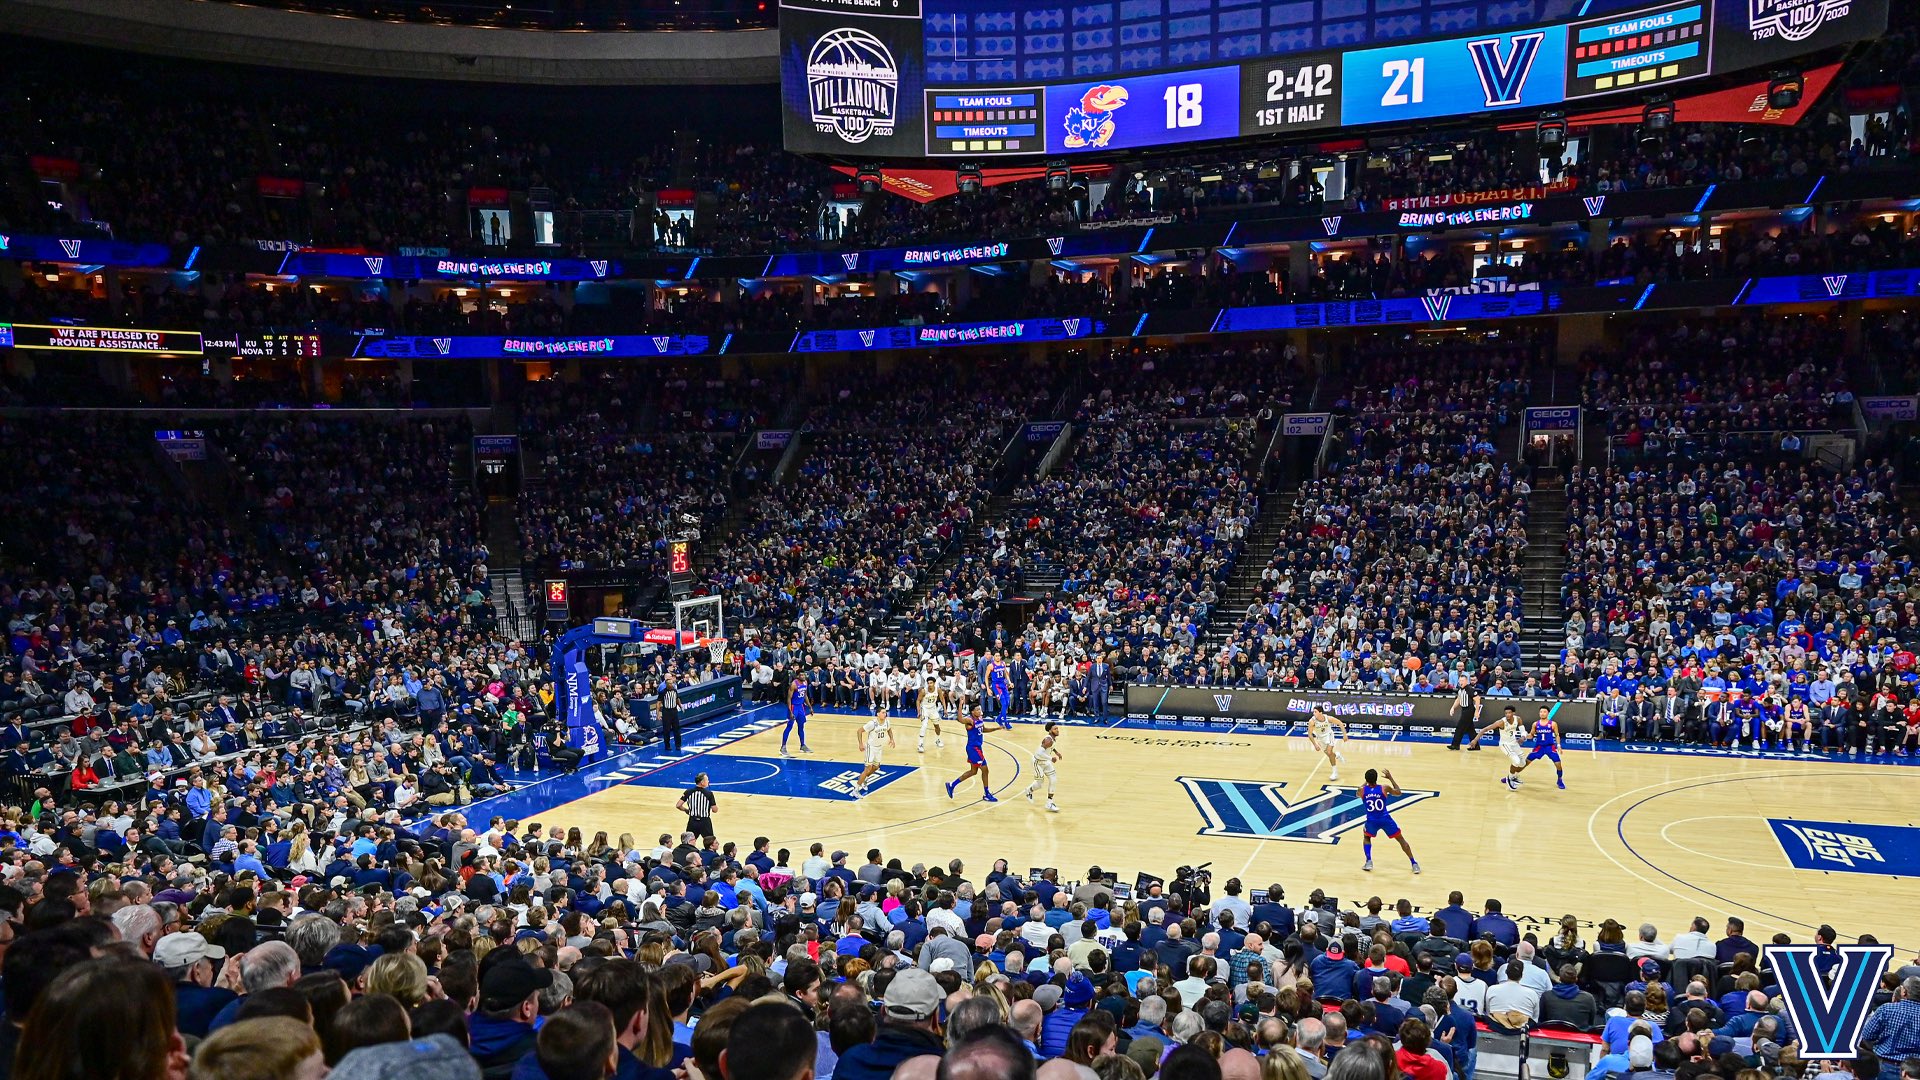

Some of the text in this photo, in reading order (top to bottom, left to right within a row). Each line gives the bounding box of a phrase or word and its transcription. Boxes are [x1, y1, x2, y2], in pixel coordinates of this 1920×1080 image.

[1789, 6, 1815, 27] 100
[1826, 5, 1850, 21] 2020
[1607, 14, 1673, 36] TEAM FOULS
[1752, 26, 1775, 41] 1920
[1611, 51, 1666, 70] TIMEOUTS
[1266, 63, 1333, 102] 2:42
[1380, 57, 1425, 107] 21
[815, 79, 889, 115] VILLANOVA
[958, 97, 1012, 107] TEAM FOULS
[832, 107, 874, 117] BASKETBALL
[1163, 83, 1203, 129] 18
[1256, 103, 1325, 127] 1ST HALF
[816, 123, 893, 136] 1920 2020
[843, 116, 865, 131] 100
[1081, 118, 1098, 130] KU
[963, 126, 1008, 137] TIMEOUTS
[1398, 203, 1533, 227] BRING THE ENERGY
[904, 242, 1008, 263] BRING THE ENERGY
[437, 261, 551, 275] BRING THE ENERGY
[57, 329, 159, 341] WE ARE PLEASED TO
[920, 322, 1024, 341] BRING THE ENERGY
[50, 338, 168, 350] PROVIDE ASSISTANCE...
[204, 340, 237, 348] 12:43 PM
[503, 337, 614, 353] BRING THE ENERGY
[1866, 400, 1911, 409] GEICO
[1289, 416, 1324, 424] GEICO
[1532, 409, 1571, 418] GEICO
[1030, 424, 1061, 432] GEICO
[1286, 426, 1302, 434] 102
[1528, 419, 1575, 429] 101 124
[477, 446, 491, 454] 105
[672, 553, 687, 572] 25
[551, 590, 563, 600] 25
[566, 672, 578, 697] NJM
[1331, 702, 1359, 716] THE
[1359, 701, 1415, 717] ENERGY
[590, 719, 788, 781] VILLANOVA
[1661, 746, 1831, 760] HONDA
[817, 770, 861, 790] BIG
[1366, 798, 1384, 812] 30
[1801, 827, 1856, 867] EAST
[1834, 832, 1886, 862] BIG
